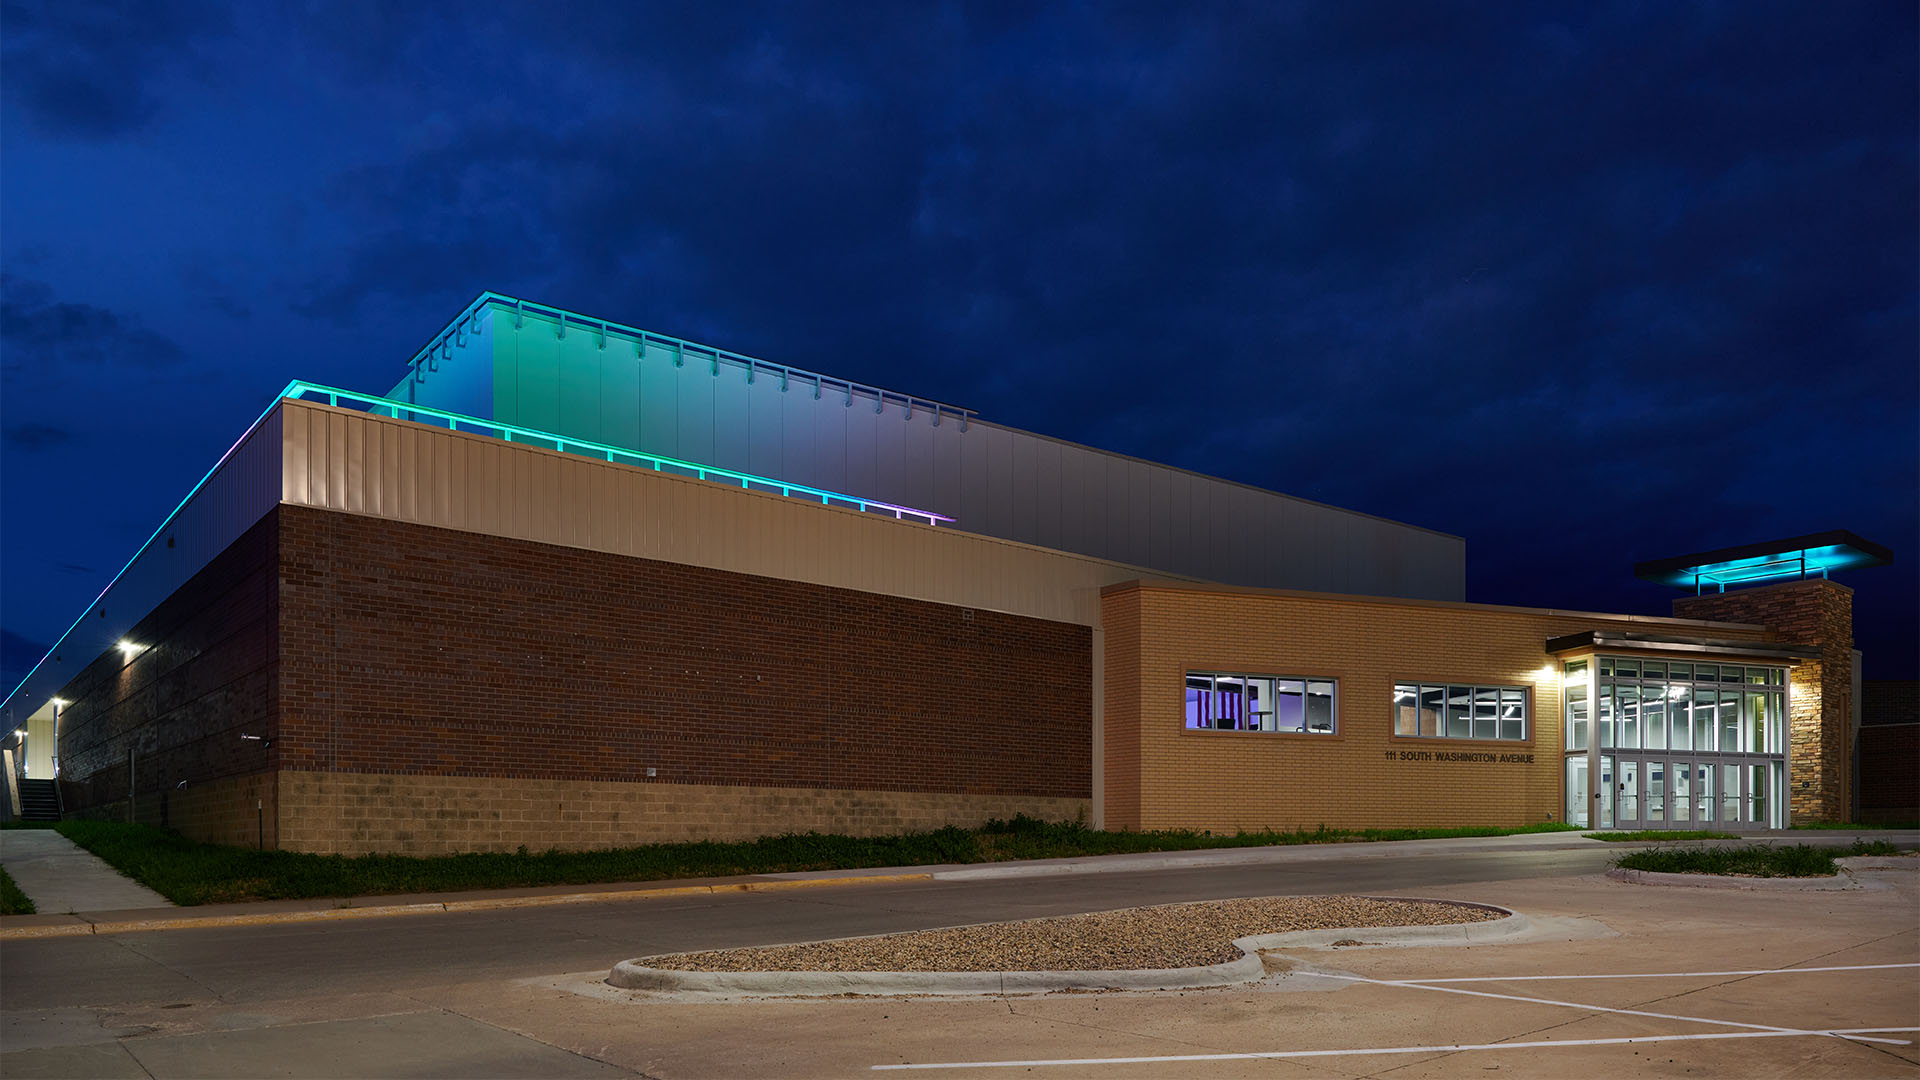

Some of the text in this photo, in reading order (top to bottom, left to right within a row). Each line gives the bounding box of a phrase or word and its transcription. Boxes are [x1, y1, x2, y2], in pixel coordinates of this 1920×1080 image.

[1385, 751, 1534, 763] 111 SOUTH WASHINGTON AVENUE
